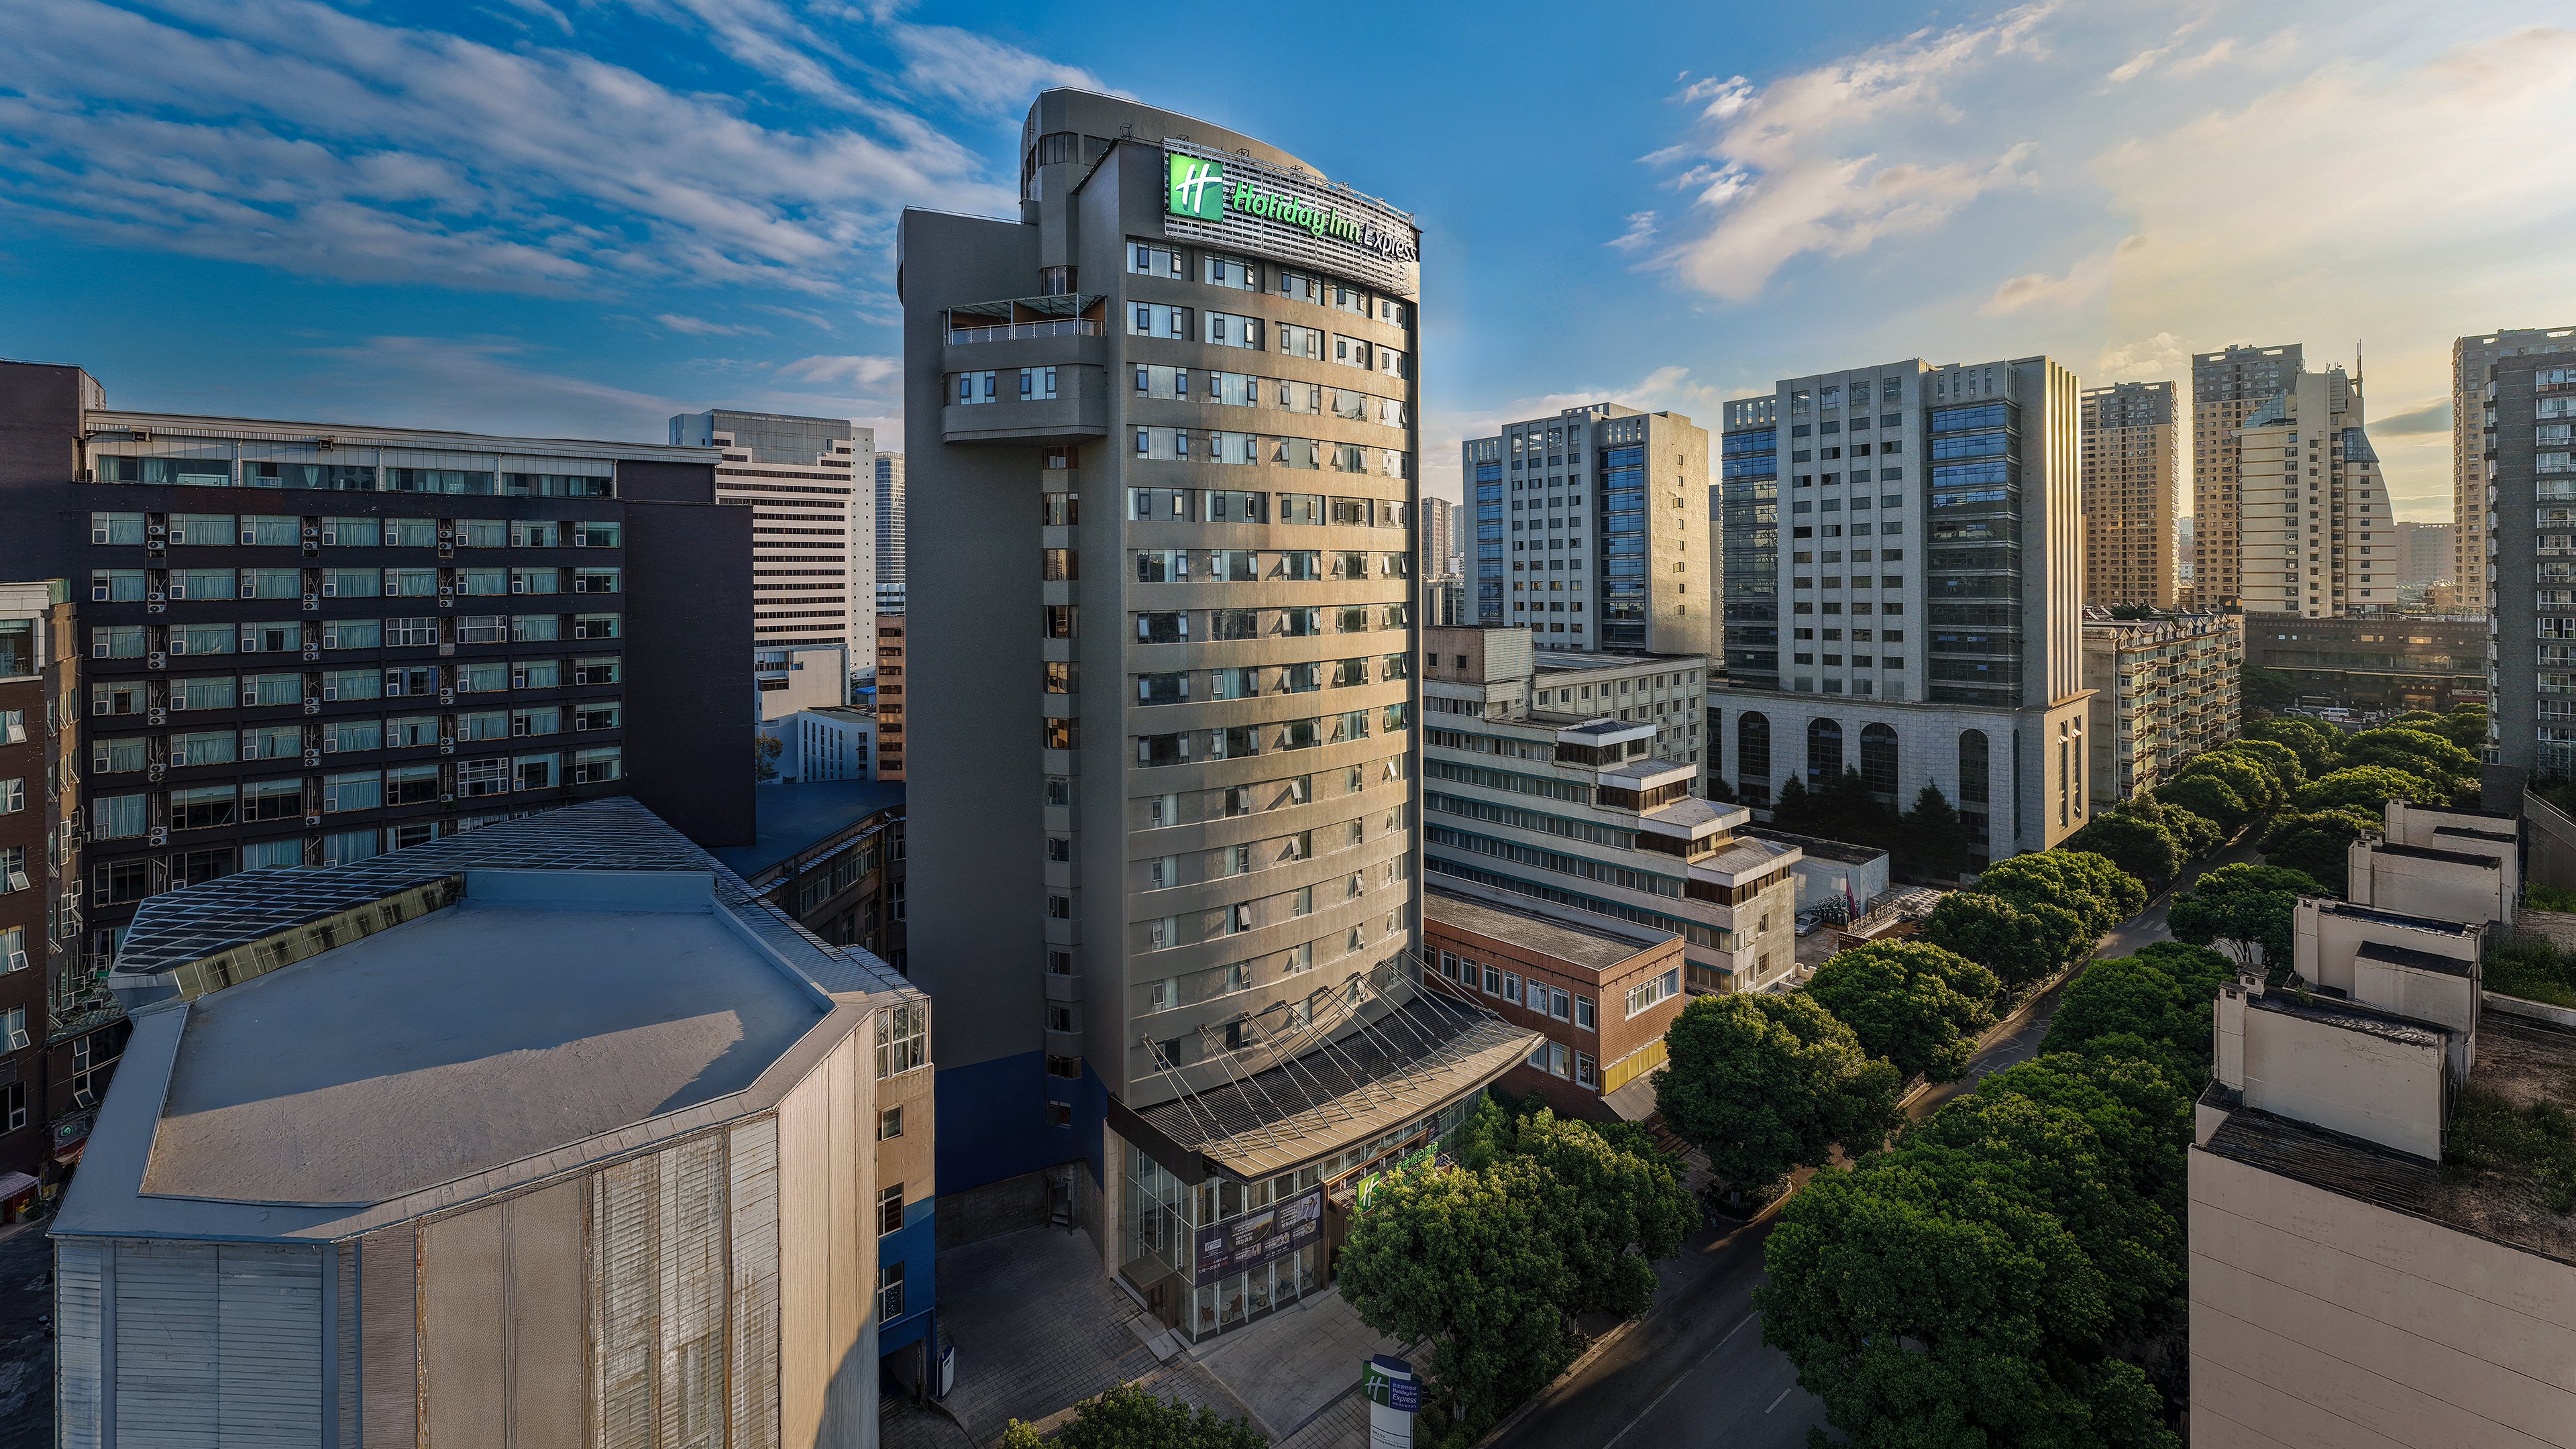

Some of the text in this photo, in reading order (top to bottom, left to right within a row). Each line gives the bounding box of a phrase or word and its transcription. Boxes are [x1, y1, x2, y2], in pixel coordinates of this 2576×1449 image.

[1232, 180, 1417, 263] Holiday Inn Express
[1392, 1388, 1409, 1397] Holiday
[1392, 1393, 1417, 1403] Express
